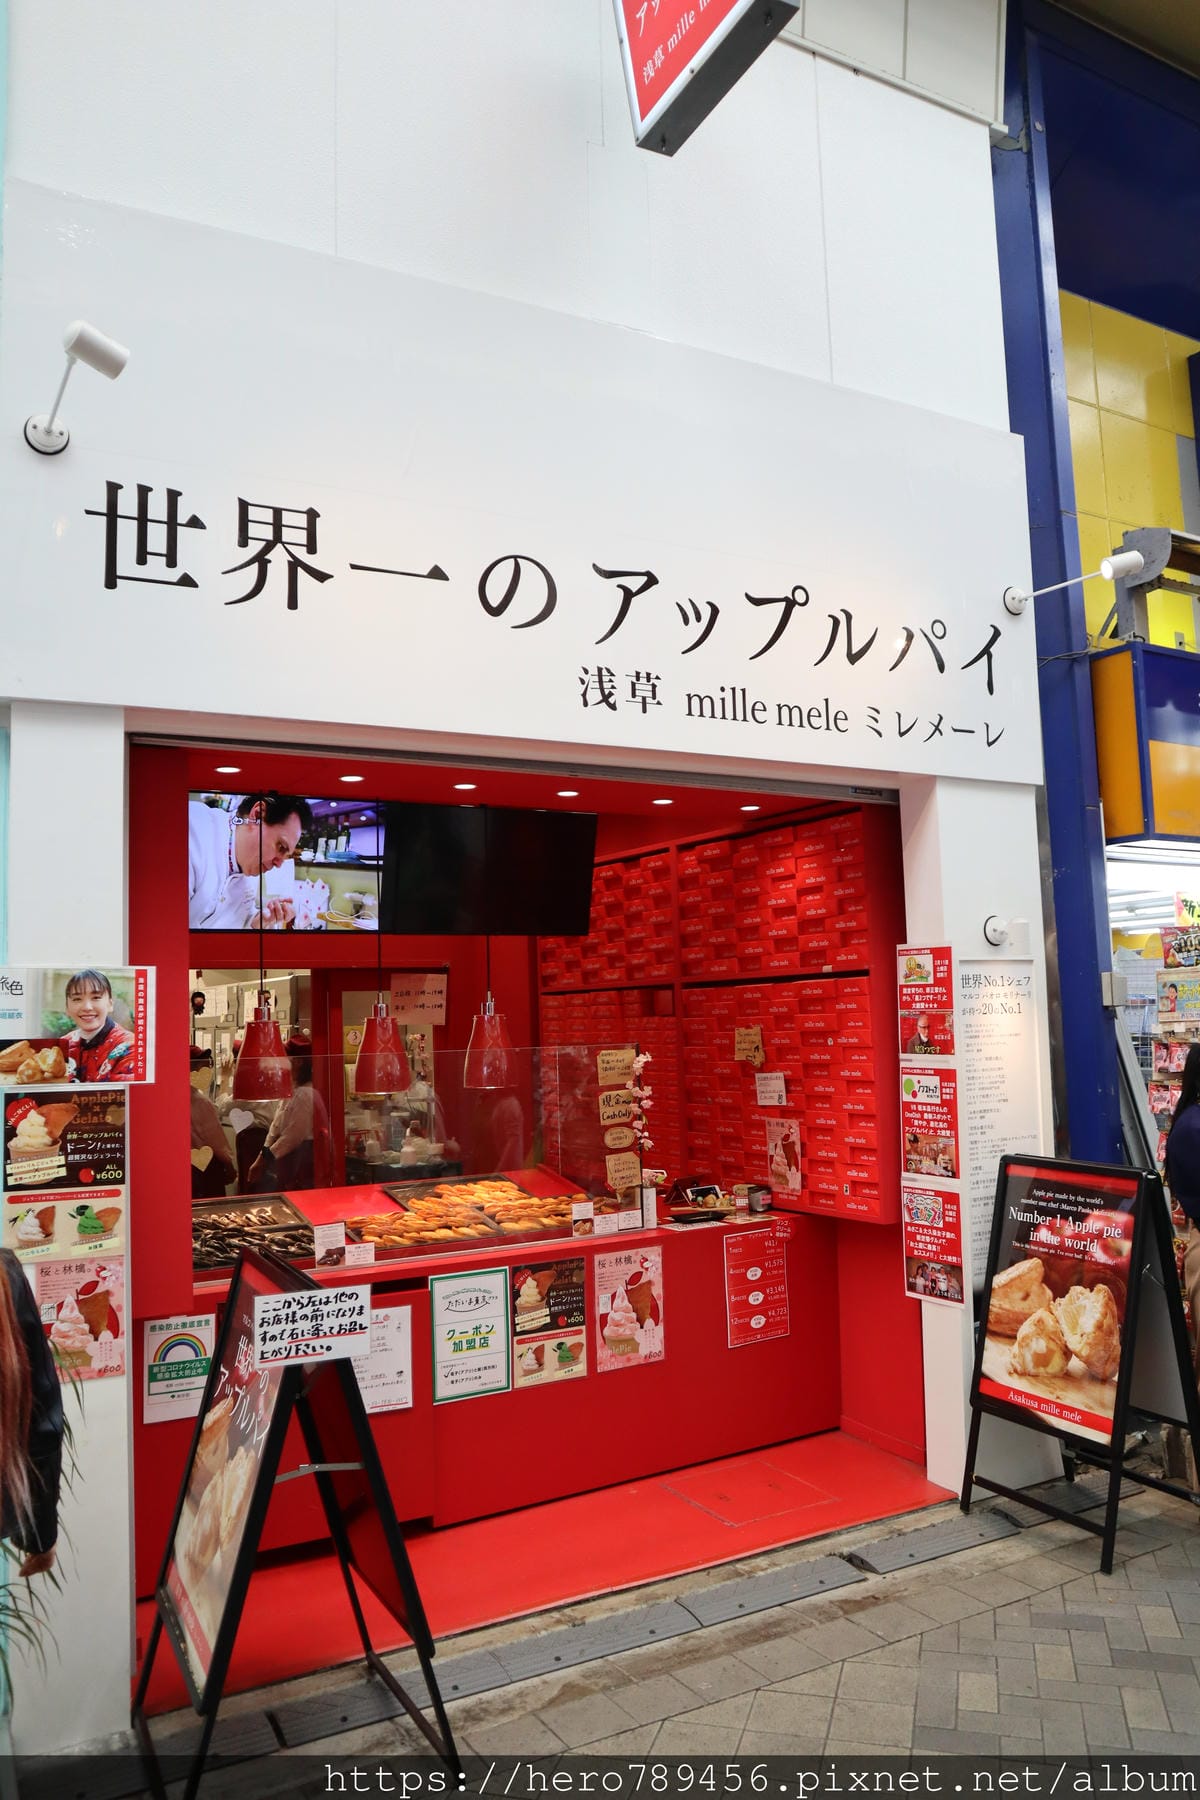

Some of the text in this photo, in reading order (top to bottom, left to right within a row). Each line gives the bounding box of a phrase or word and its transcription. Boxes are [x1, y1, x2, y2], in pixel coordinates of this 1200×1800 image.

[643, 10, 695, 85] 浅草 mille
[84, 481, 1001, 697] 世界一のアップルパイ
[579, 667, 1004, 746] 浅草 mille mele ミレメーレ
[961, 974, 1031, 989] 世界No.1シェフ
[96, 1170, 123, 1180] ¥600
[1008, 1206, 1122, 1238] Number 1 Apple pie
[1029, 1227, 1098, 1253] in the world
[262, 1292, 359, 1313] ここから左は他の
[446, 1323, 494, 1341] クーポン
[452, 1336, 489, 1353] 加盟店
[1008, 1391, 1082, 1422] Asakusa mille mele
